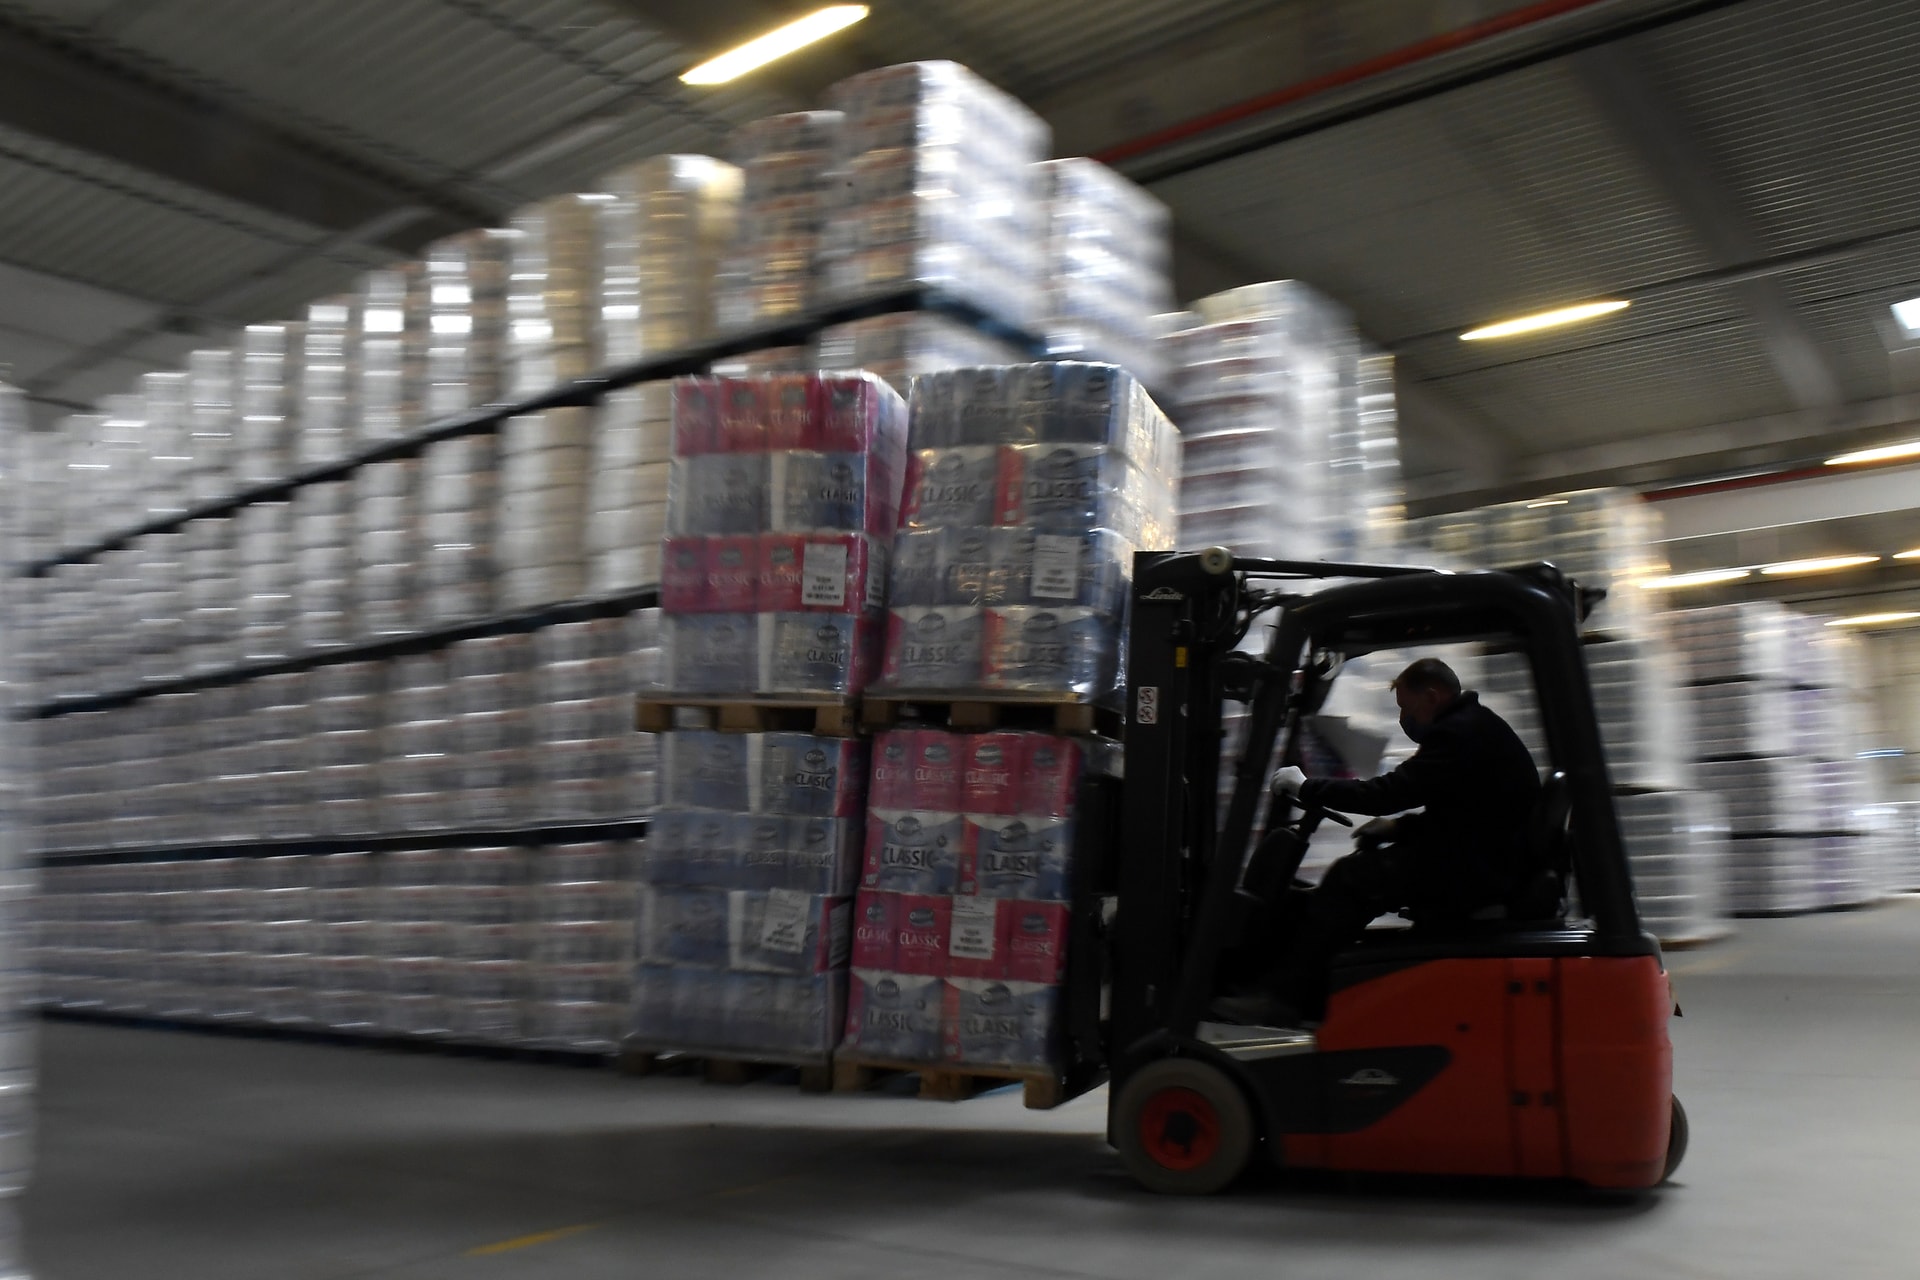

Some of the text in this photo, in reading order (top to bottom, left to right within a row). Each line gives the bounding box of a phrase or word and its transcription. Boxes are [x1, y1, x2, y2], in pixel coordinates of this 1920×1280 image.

[922, 484, 977, 503] CLASSIC
[807, 649, 842, 664] CLASIC
[901, 645, 962, 664] CLASSIC
[795, 773, 832, 789] CLASIC
[882, 847, 935, 869] CLASSIC
[857, 927, 892, 943] CLASIC
[900, 932, 941, 949] CLASSIC
